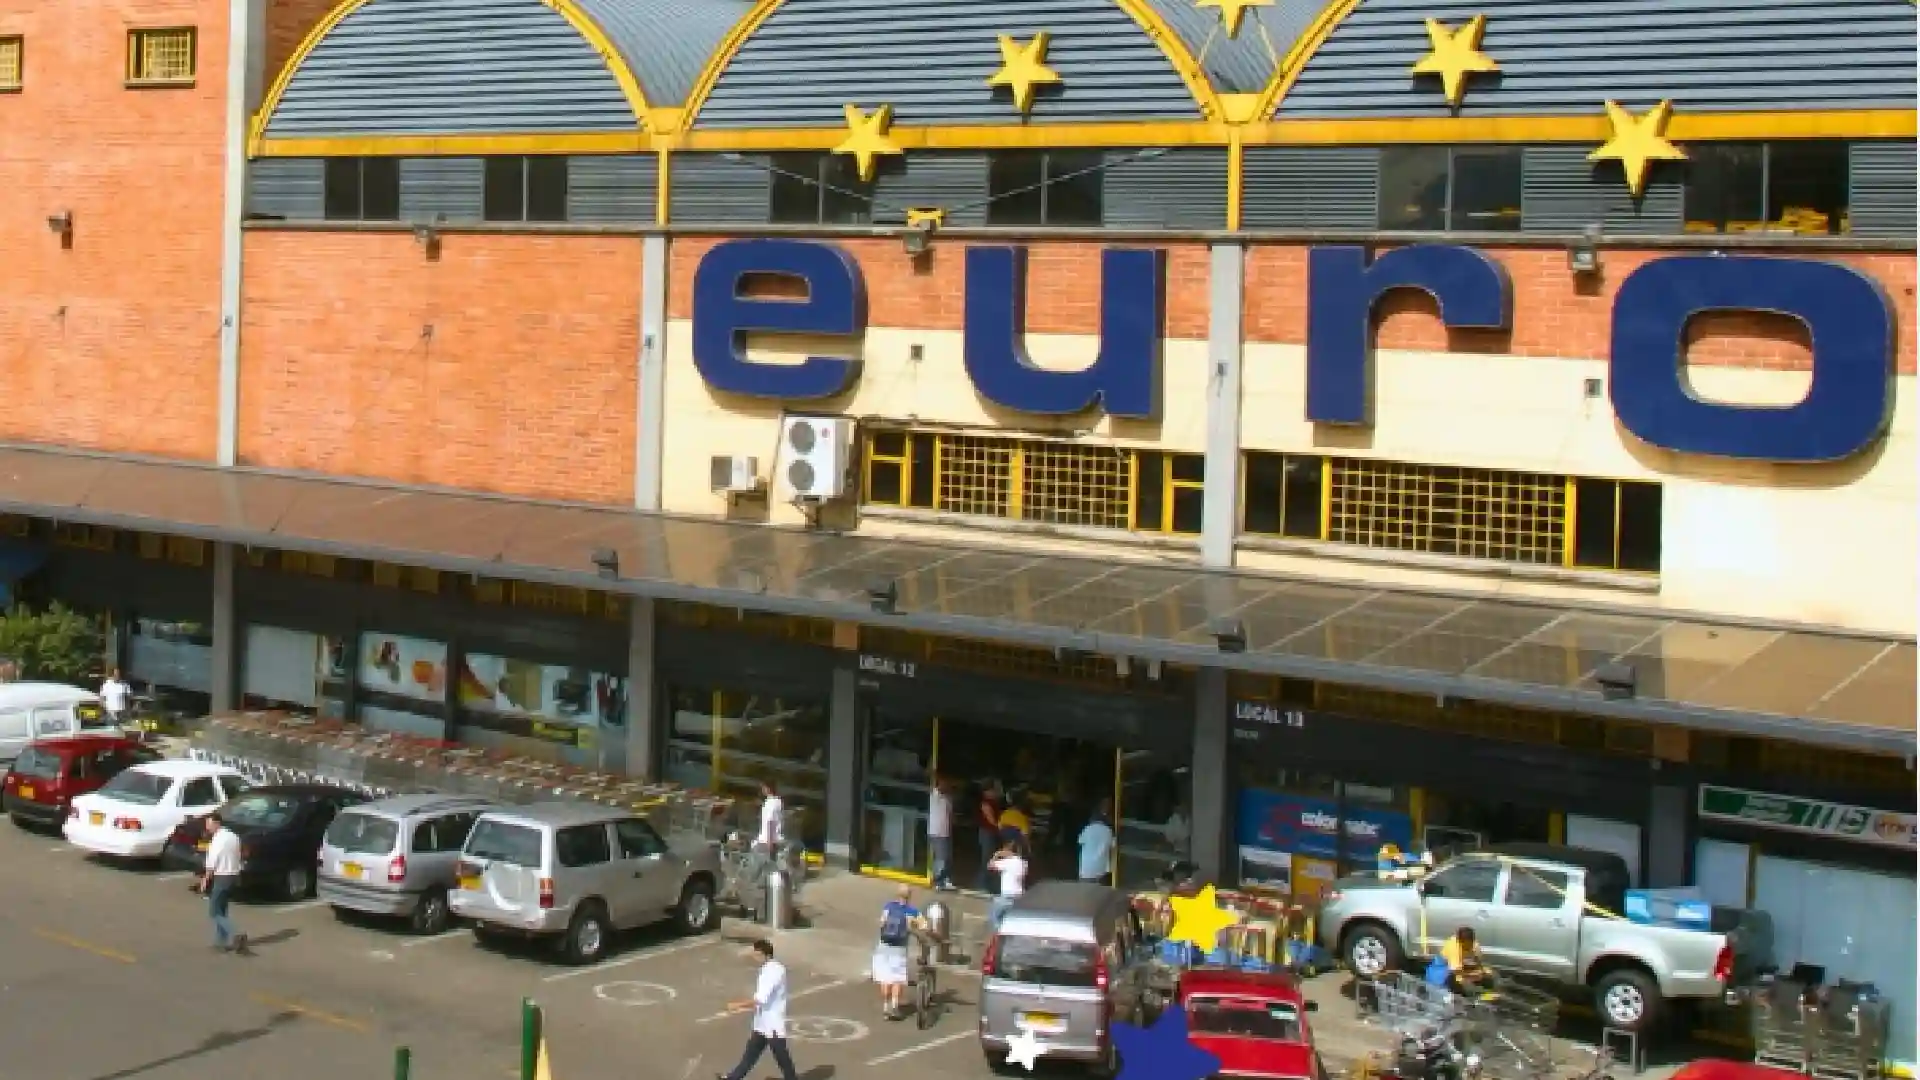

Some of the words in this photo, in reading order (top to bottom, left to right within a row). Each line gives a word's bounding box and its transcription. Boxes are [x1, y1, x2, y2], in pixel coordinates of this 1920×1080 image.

[692, 238, 1896, 463] euro
[859, 654, 897, 675] LOCAL
[1235, 701, 1281, 724] LOCAL
